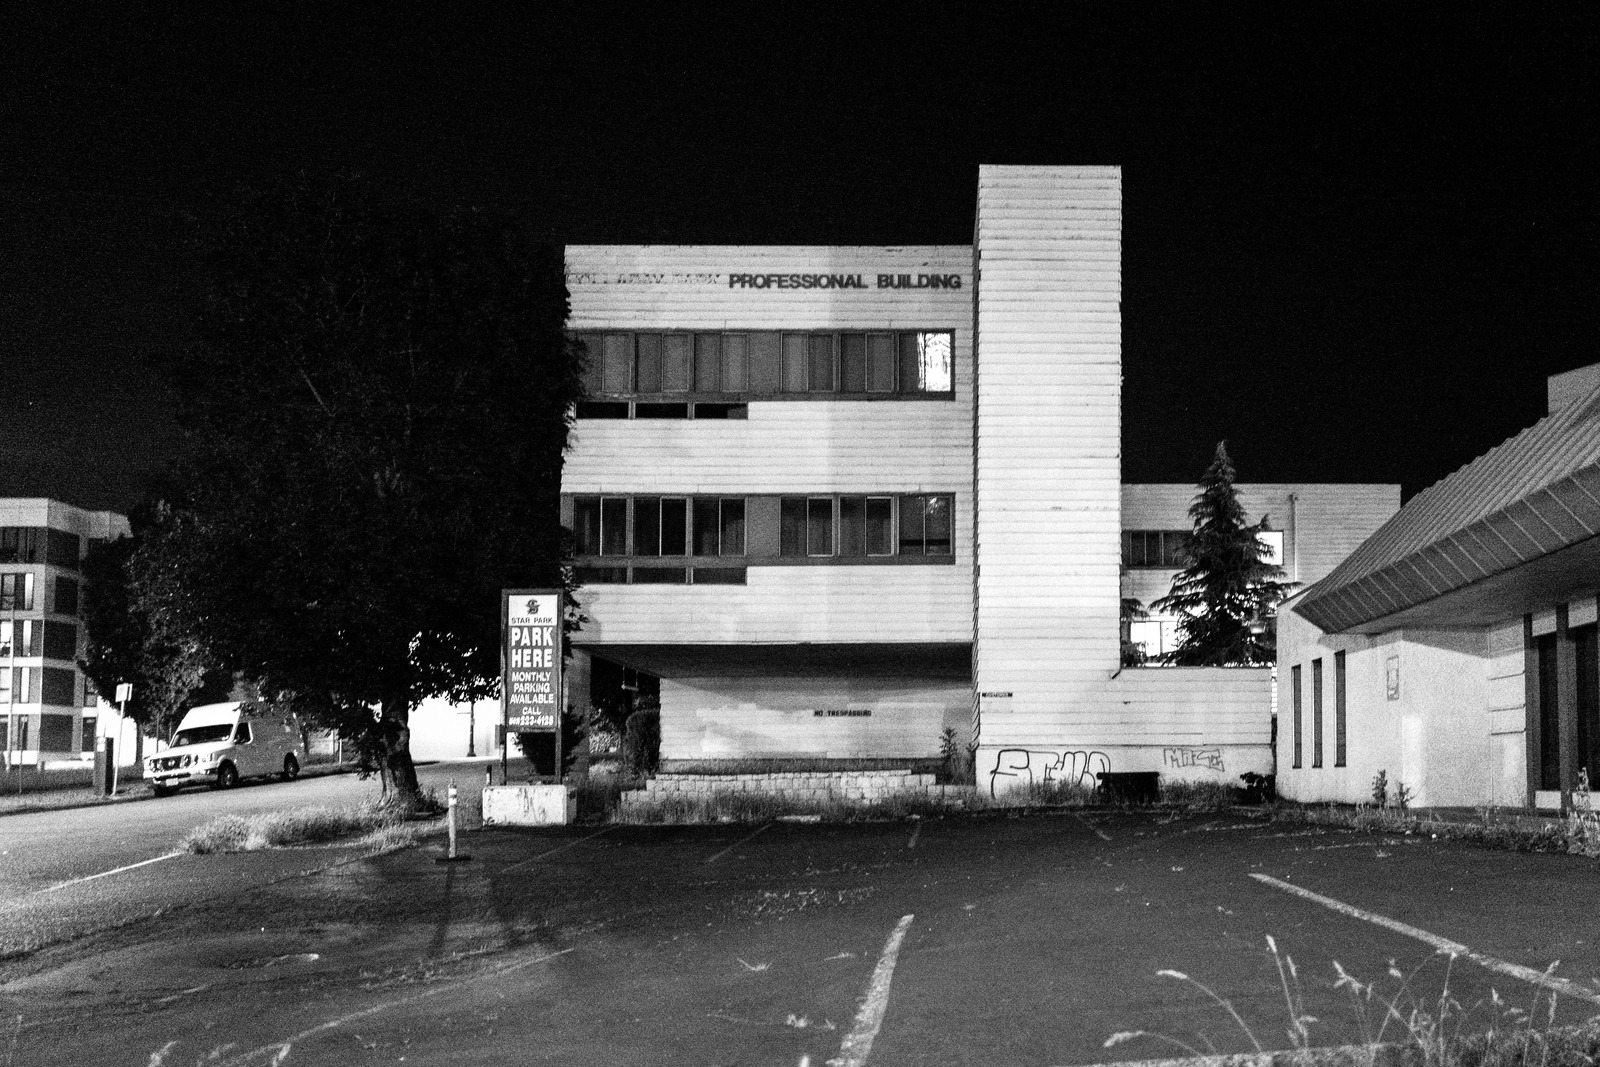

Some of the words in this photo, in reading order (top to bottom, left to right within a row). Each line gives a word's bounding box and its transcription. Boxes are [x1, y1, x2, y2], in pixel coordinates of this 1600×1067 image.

[729, 273, 868, 289] PROFESSIONAL
[877, 273, 962, 289] BUILDING
[511, 626, 553, 647] PARK
[511, 648, 553, 668] HERE
[511, 671, 551, 682] MONTHLY
[513, 682, 551, 693] PARKING
[510, 693, 554, 704] AVAILABLE
[522, 706, 541, 715] CALL
